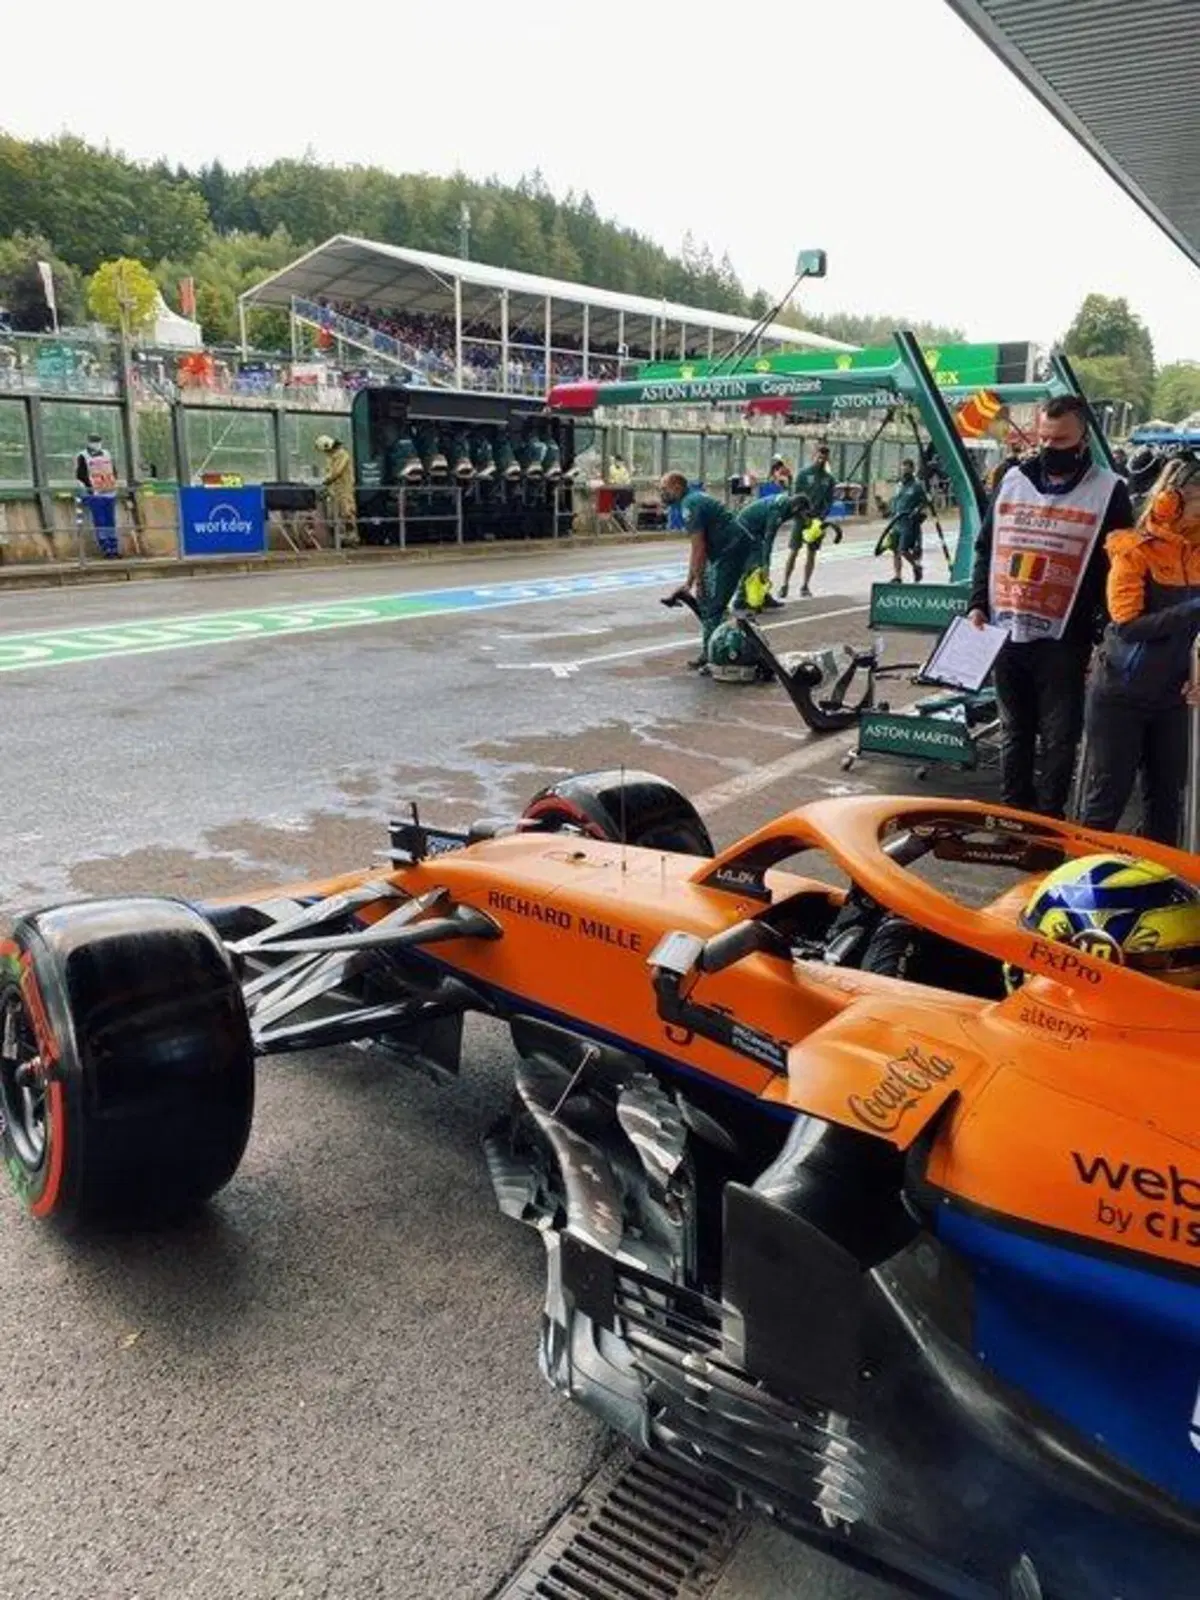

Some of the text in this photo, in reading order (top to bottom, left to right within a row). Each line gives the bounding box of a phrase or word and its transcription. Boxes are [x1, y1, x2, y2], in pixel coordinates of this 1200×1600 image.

[641, 381, 747, 400] ASTON MARTIN
[760, 379, 822, 395] Cognizant
[832, 394, 873, 408] ASTON
[193, 517, 252, 535] workday
[876, 595, 968, 611] ASTON MARTI
[864, 723, 965, 748] ASTON MARTIN
[488, 890, 641, 952] RICHARD MILLE
[1030, 940, 1102, 985] FxPro
[1019, 1005, 1091, 1041] alteryx
[1096, 1197, 1133, 1234] by
